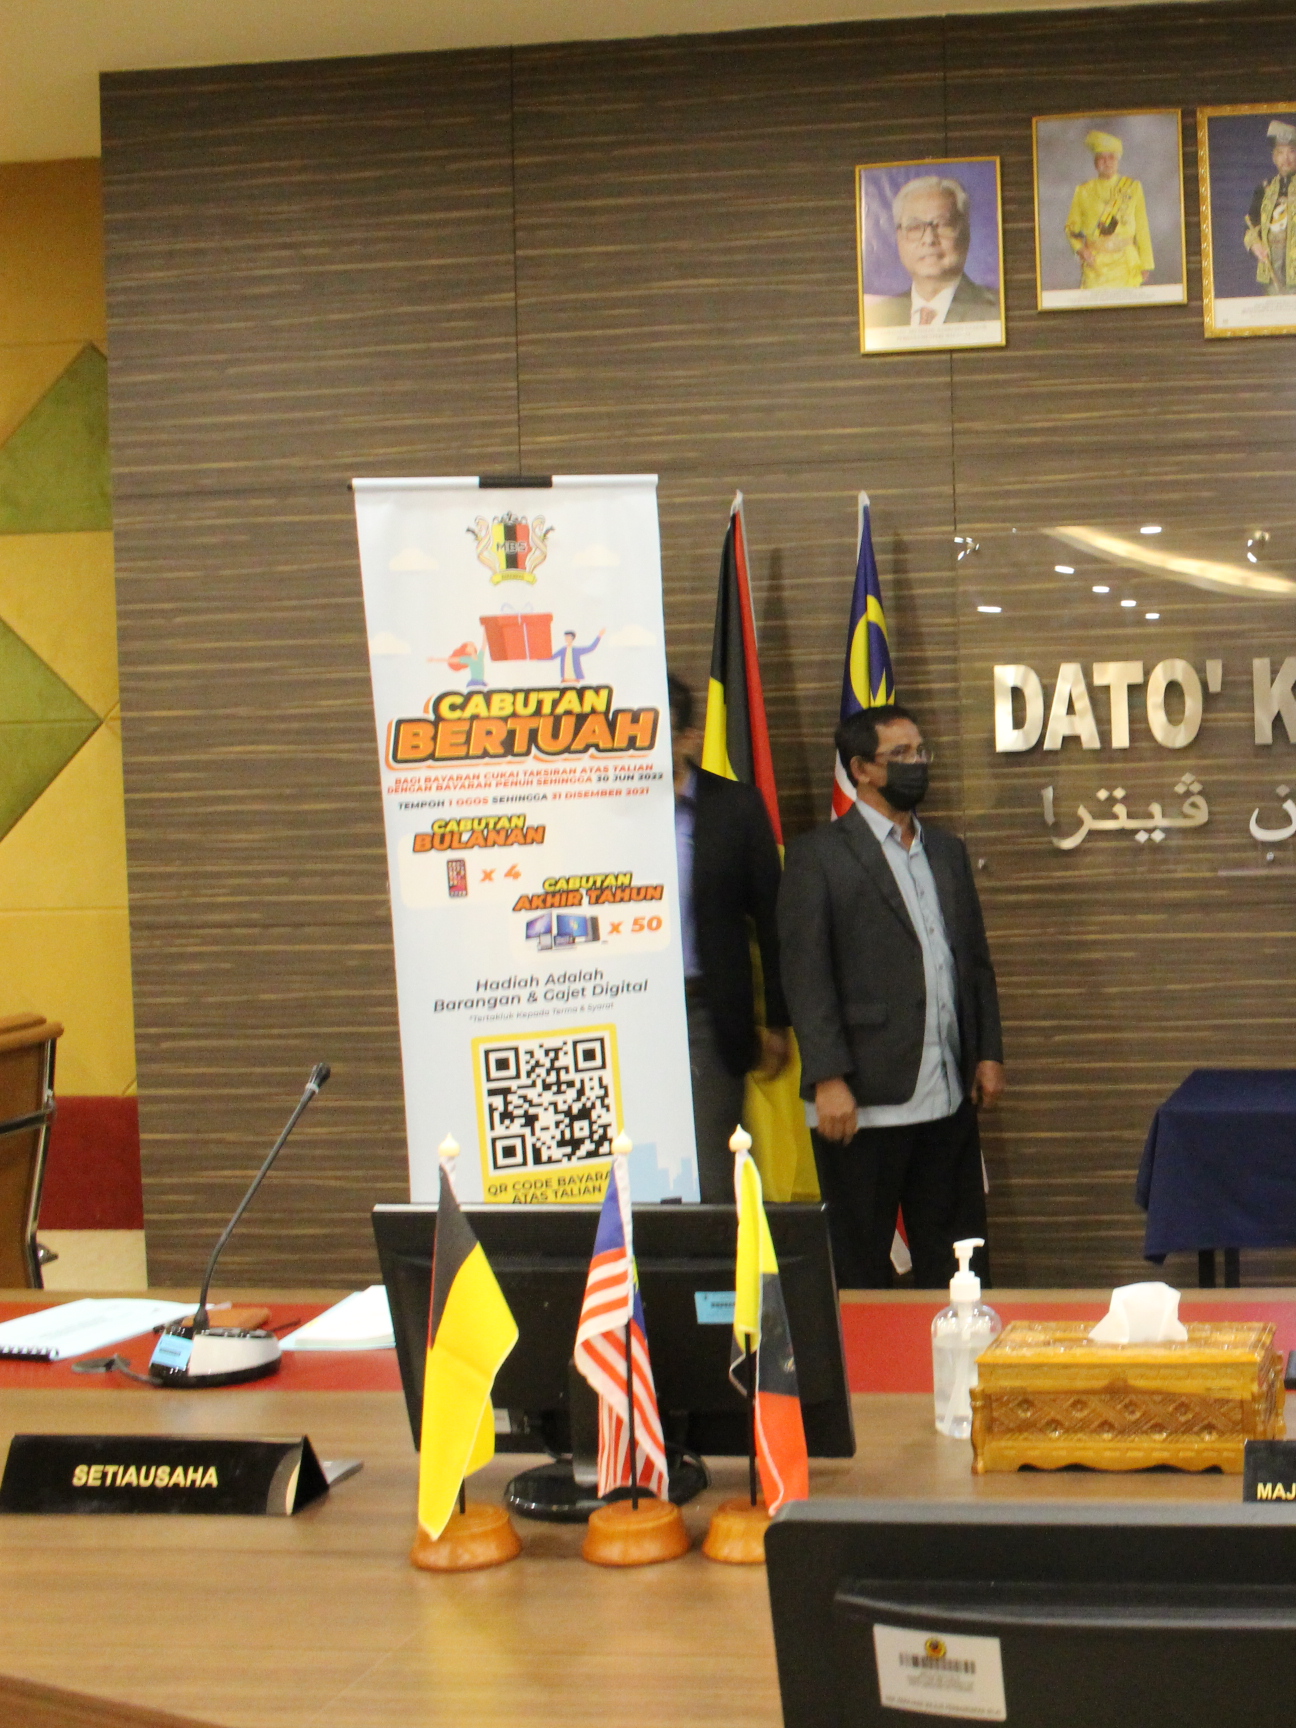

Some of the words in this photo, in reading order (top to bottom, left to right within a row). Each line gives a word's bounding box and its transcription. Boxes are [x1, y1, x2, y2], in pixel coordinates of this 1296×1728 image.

[438, 688, 609, 720] CABUTAN
[993, 658, 1223, 753] DATO'
[397, 709, 655, 760] BERTUAH
[580, 765, 609, 774] ATAS
[613, 763, 654, 773] TALIAN
[613, 773, 634, 782] JUN
[565, 788, 622, 799] DISEMBER
[432, 814, 526, 833] CABUTAN
[413, 826, 546, 853] BULANAN
[504, 864, 522, 880] 4
[543, 872, 632, 891] CABUTAN
[513, 889, 583, 912] AKHIR
[587, 885, 664, 905] TAHUN
[632, 916, 663, 933] 50
[476, 975, 539, 992] Hadiah
[545, 968, 604, 986] Adalah
[434, 993, 521, 1012] Barangan
[527, 992, 538, 1003] &
[544, 986, 587, 1004] Gajet
[592, 979, 649, 998] Digital
[488, 1184, 507, 1196] QR
[512, 1179, 553, 1191] CODE
[512, 1190, 548, 1204] ATAS
[550, 1184, 602, 1199] TALIAN
[72, 1464, 219, 1488] SETIAUSAHA
